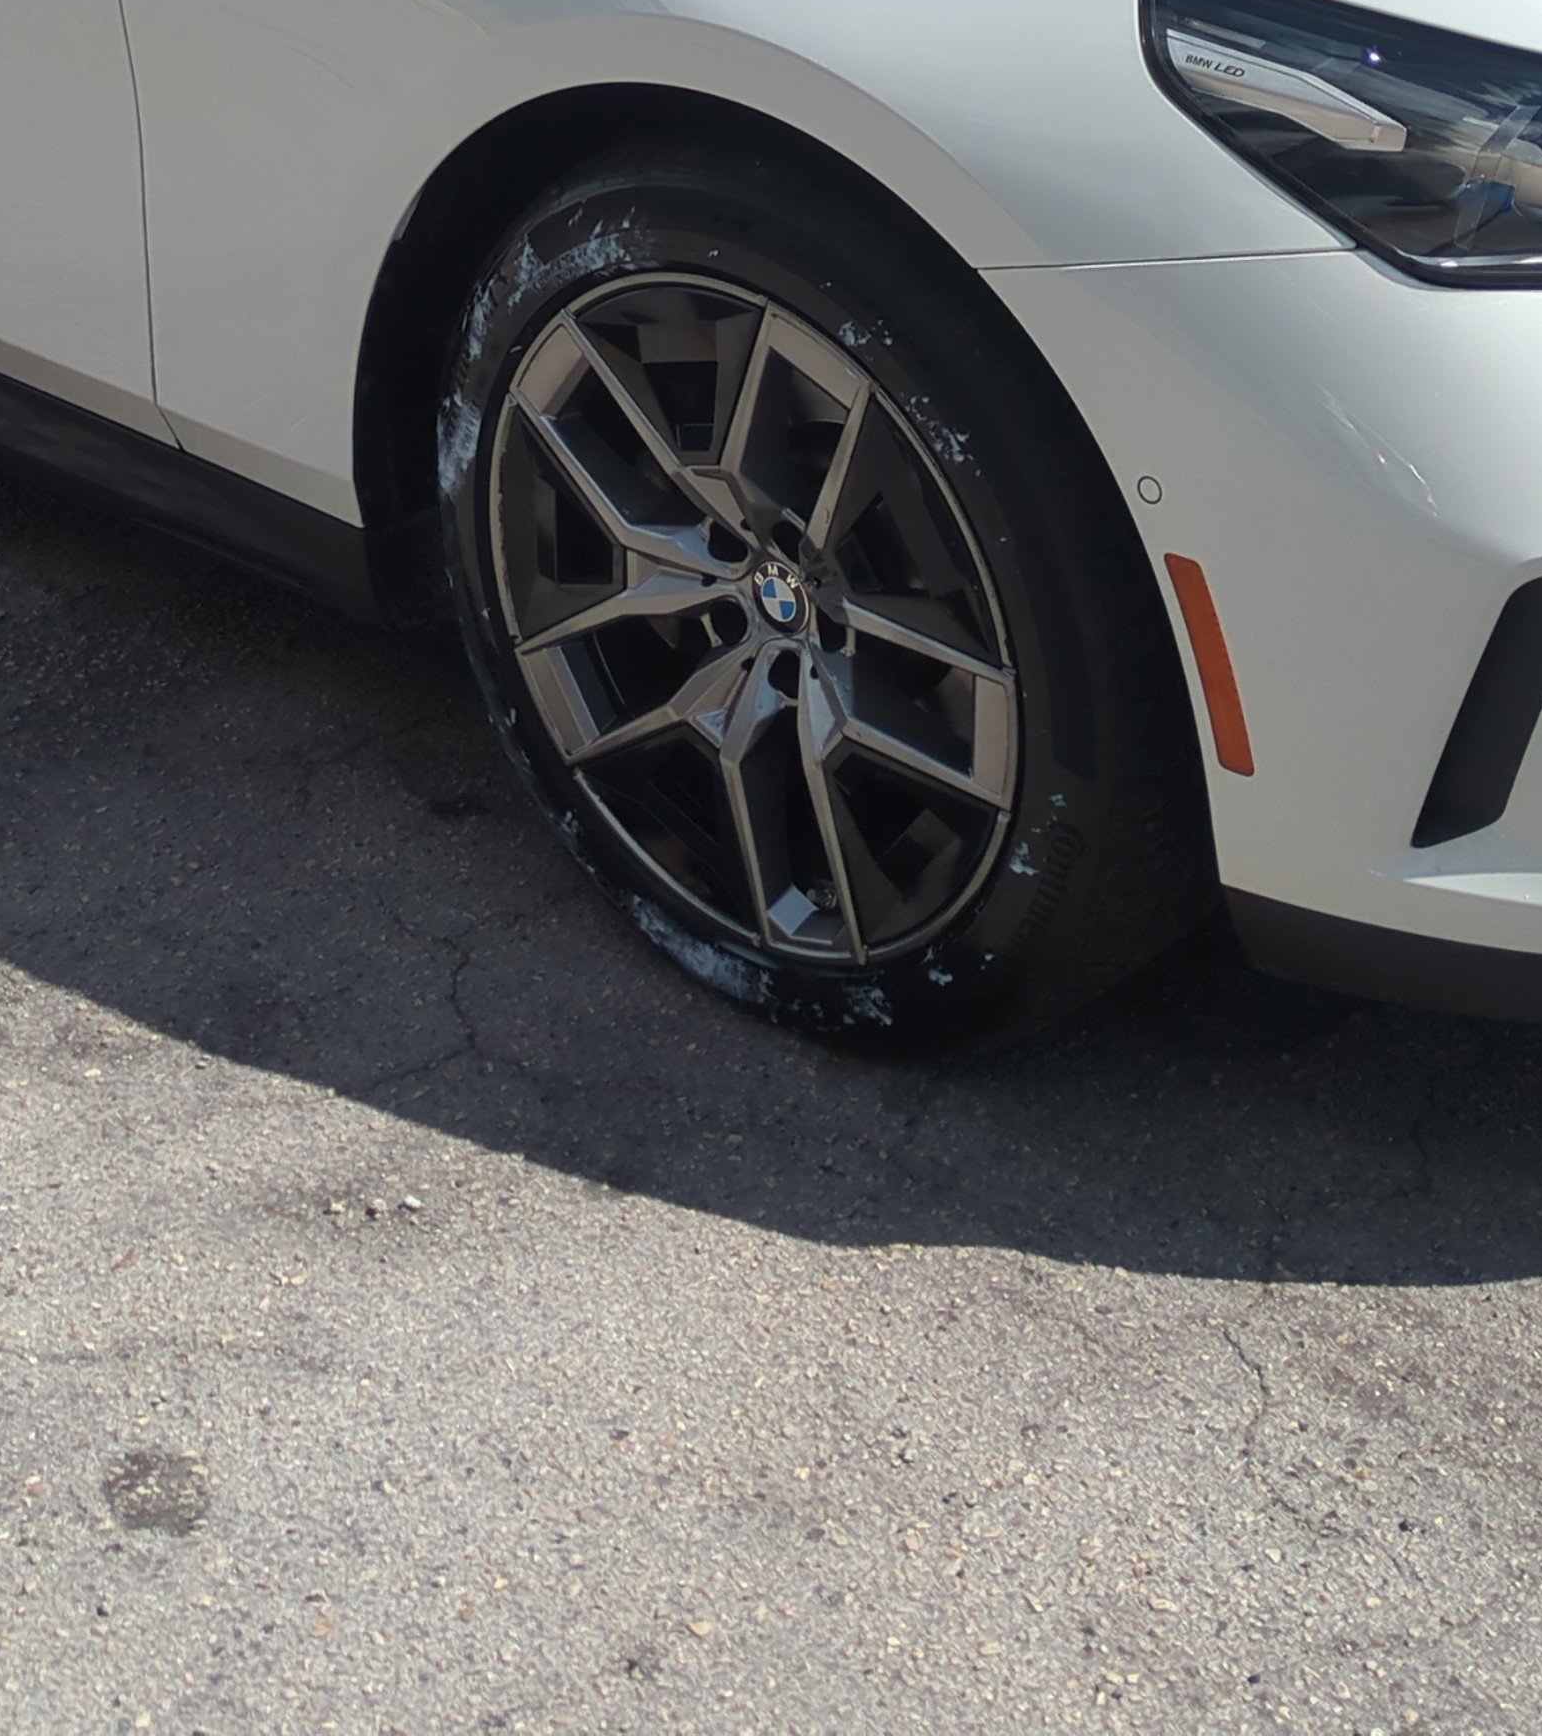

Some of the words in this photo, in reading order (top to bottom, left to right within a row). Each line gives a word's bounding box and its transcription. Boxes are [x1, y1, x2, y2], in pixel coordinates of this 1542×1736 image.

[1185, 54, 1213, 69] BMW
[1214, 62, 1245, 78] LED
[753, 563, 800, 589] BMW
